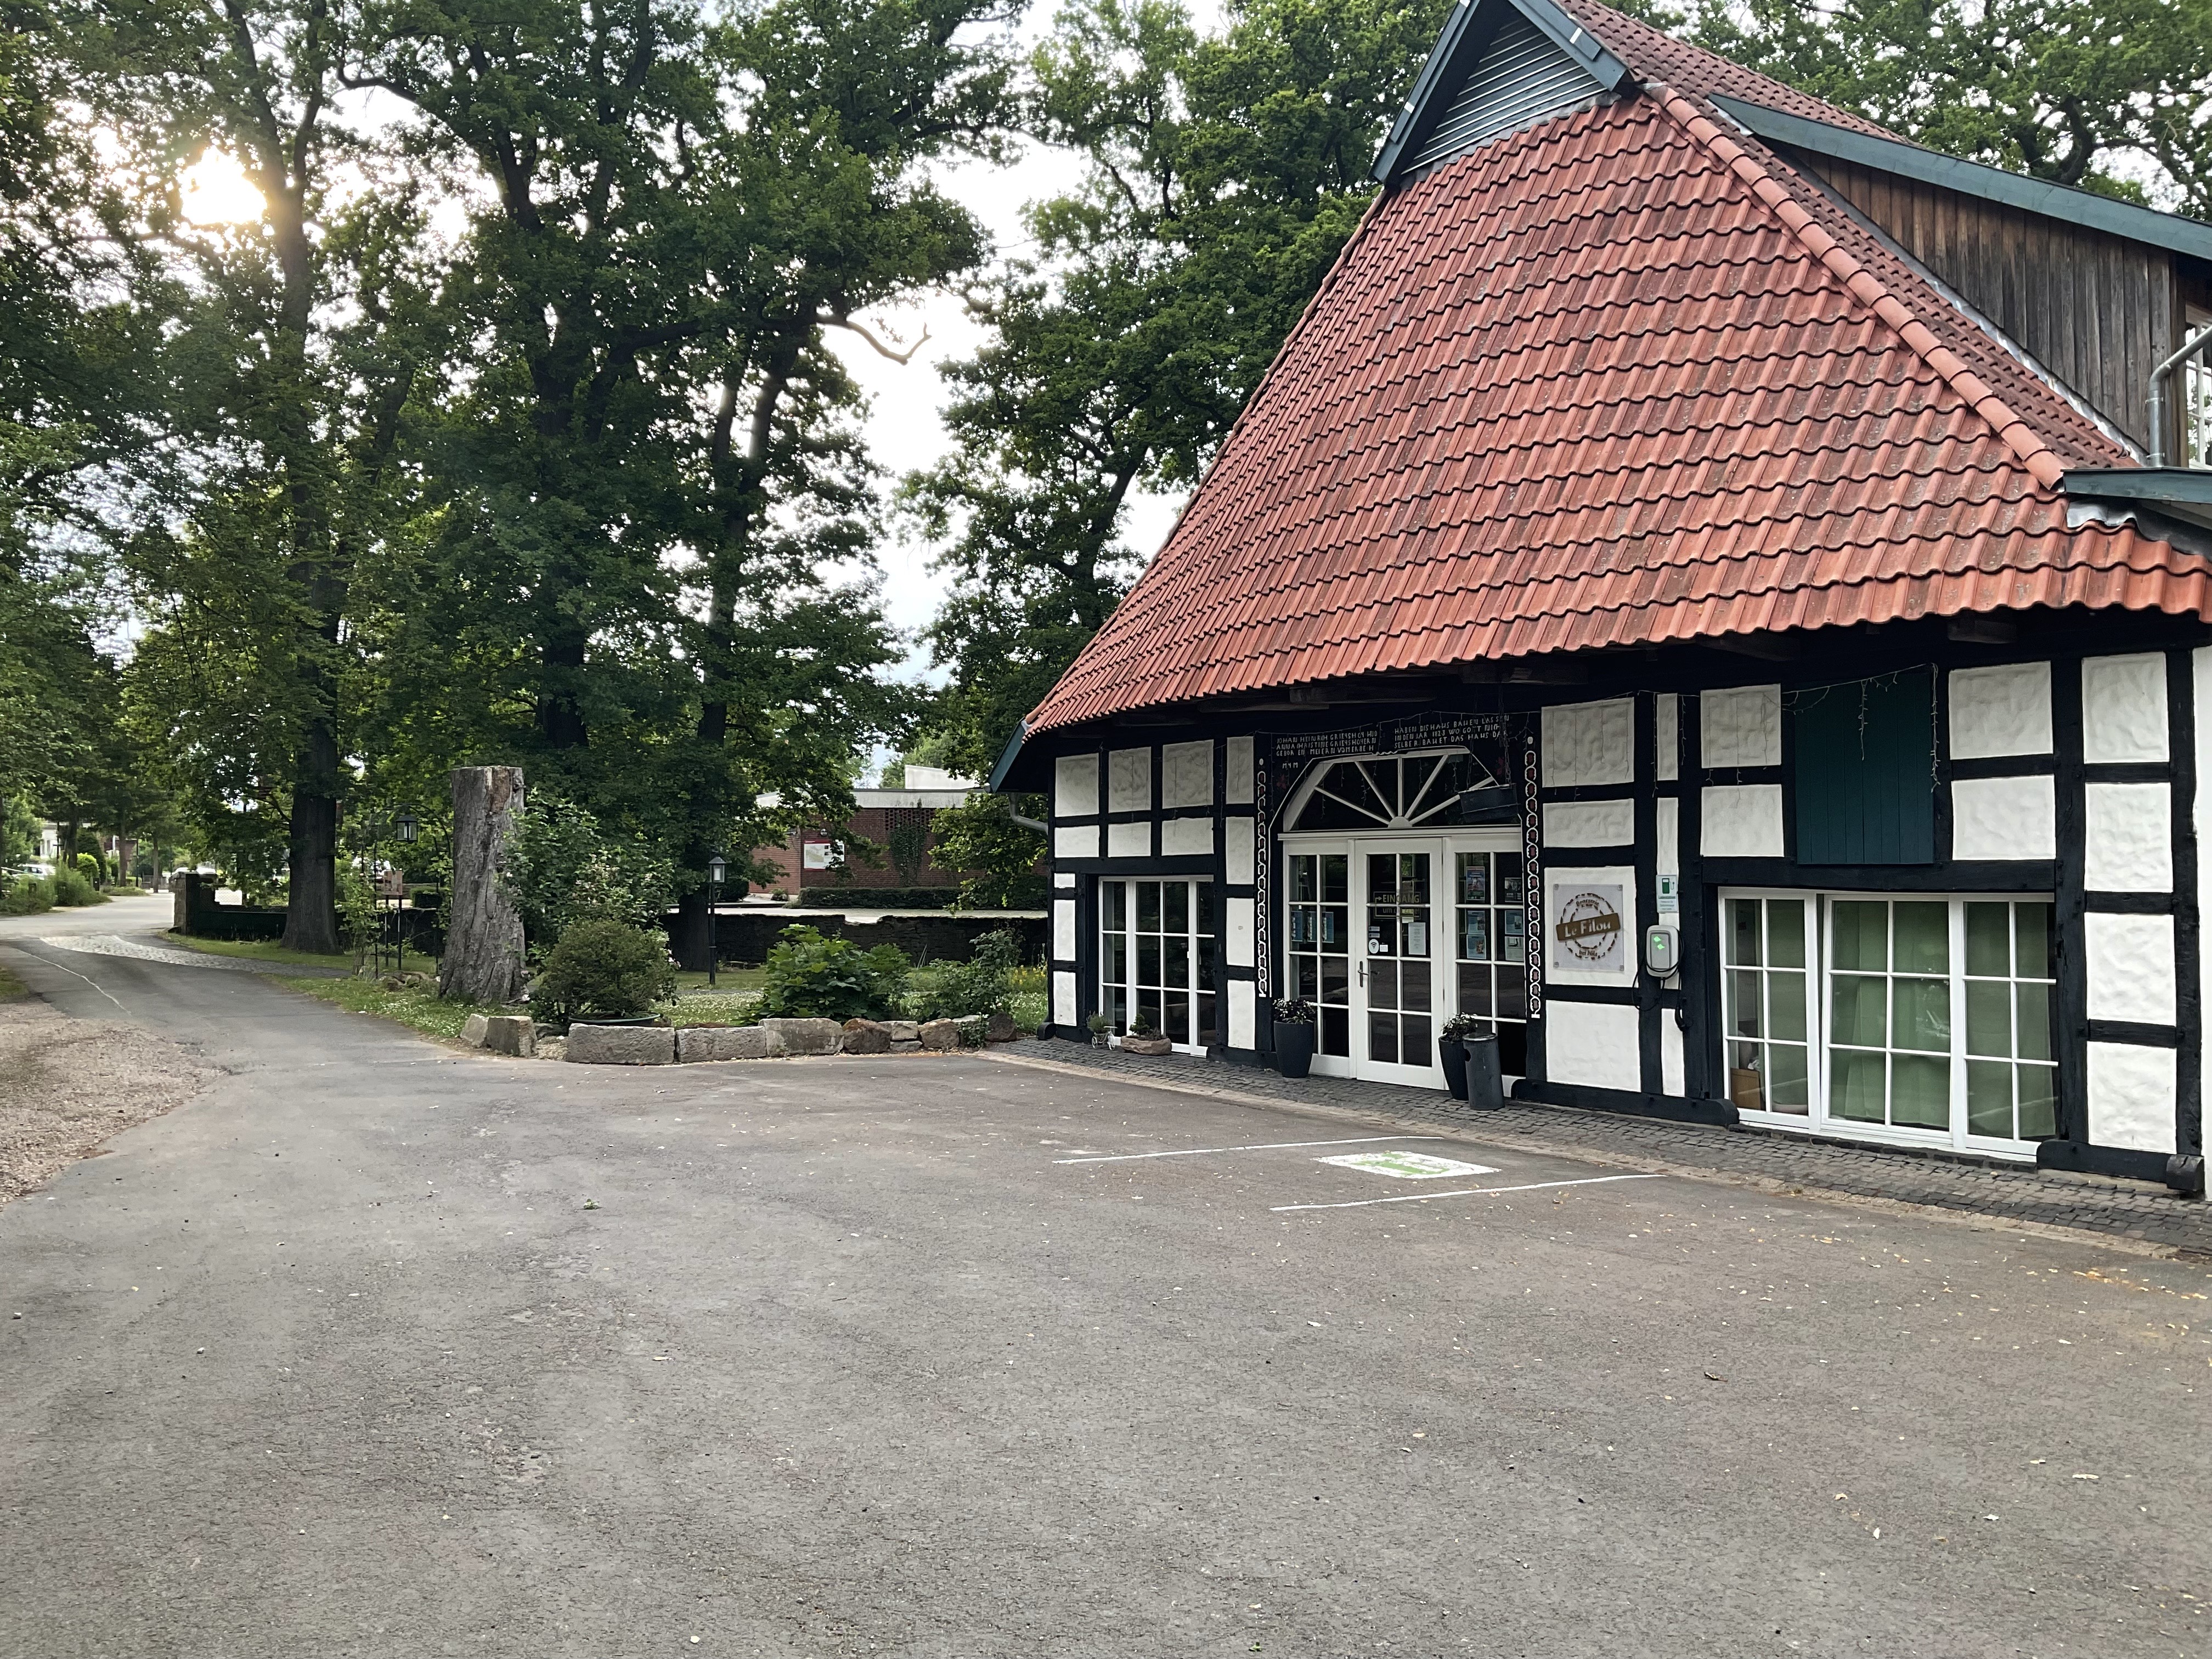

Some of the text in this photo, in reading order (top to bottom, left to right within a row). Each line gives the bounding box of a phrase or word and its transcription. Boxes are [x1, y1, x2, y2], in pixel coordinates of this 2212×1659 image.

[1395, 726, 1417, 734] HABEN
[1394, 740, 1418, 749] SELBER
[1383, 894, 1419, 903] EINANG
[1565, 919, 1611, 938] Le Filou
